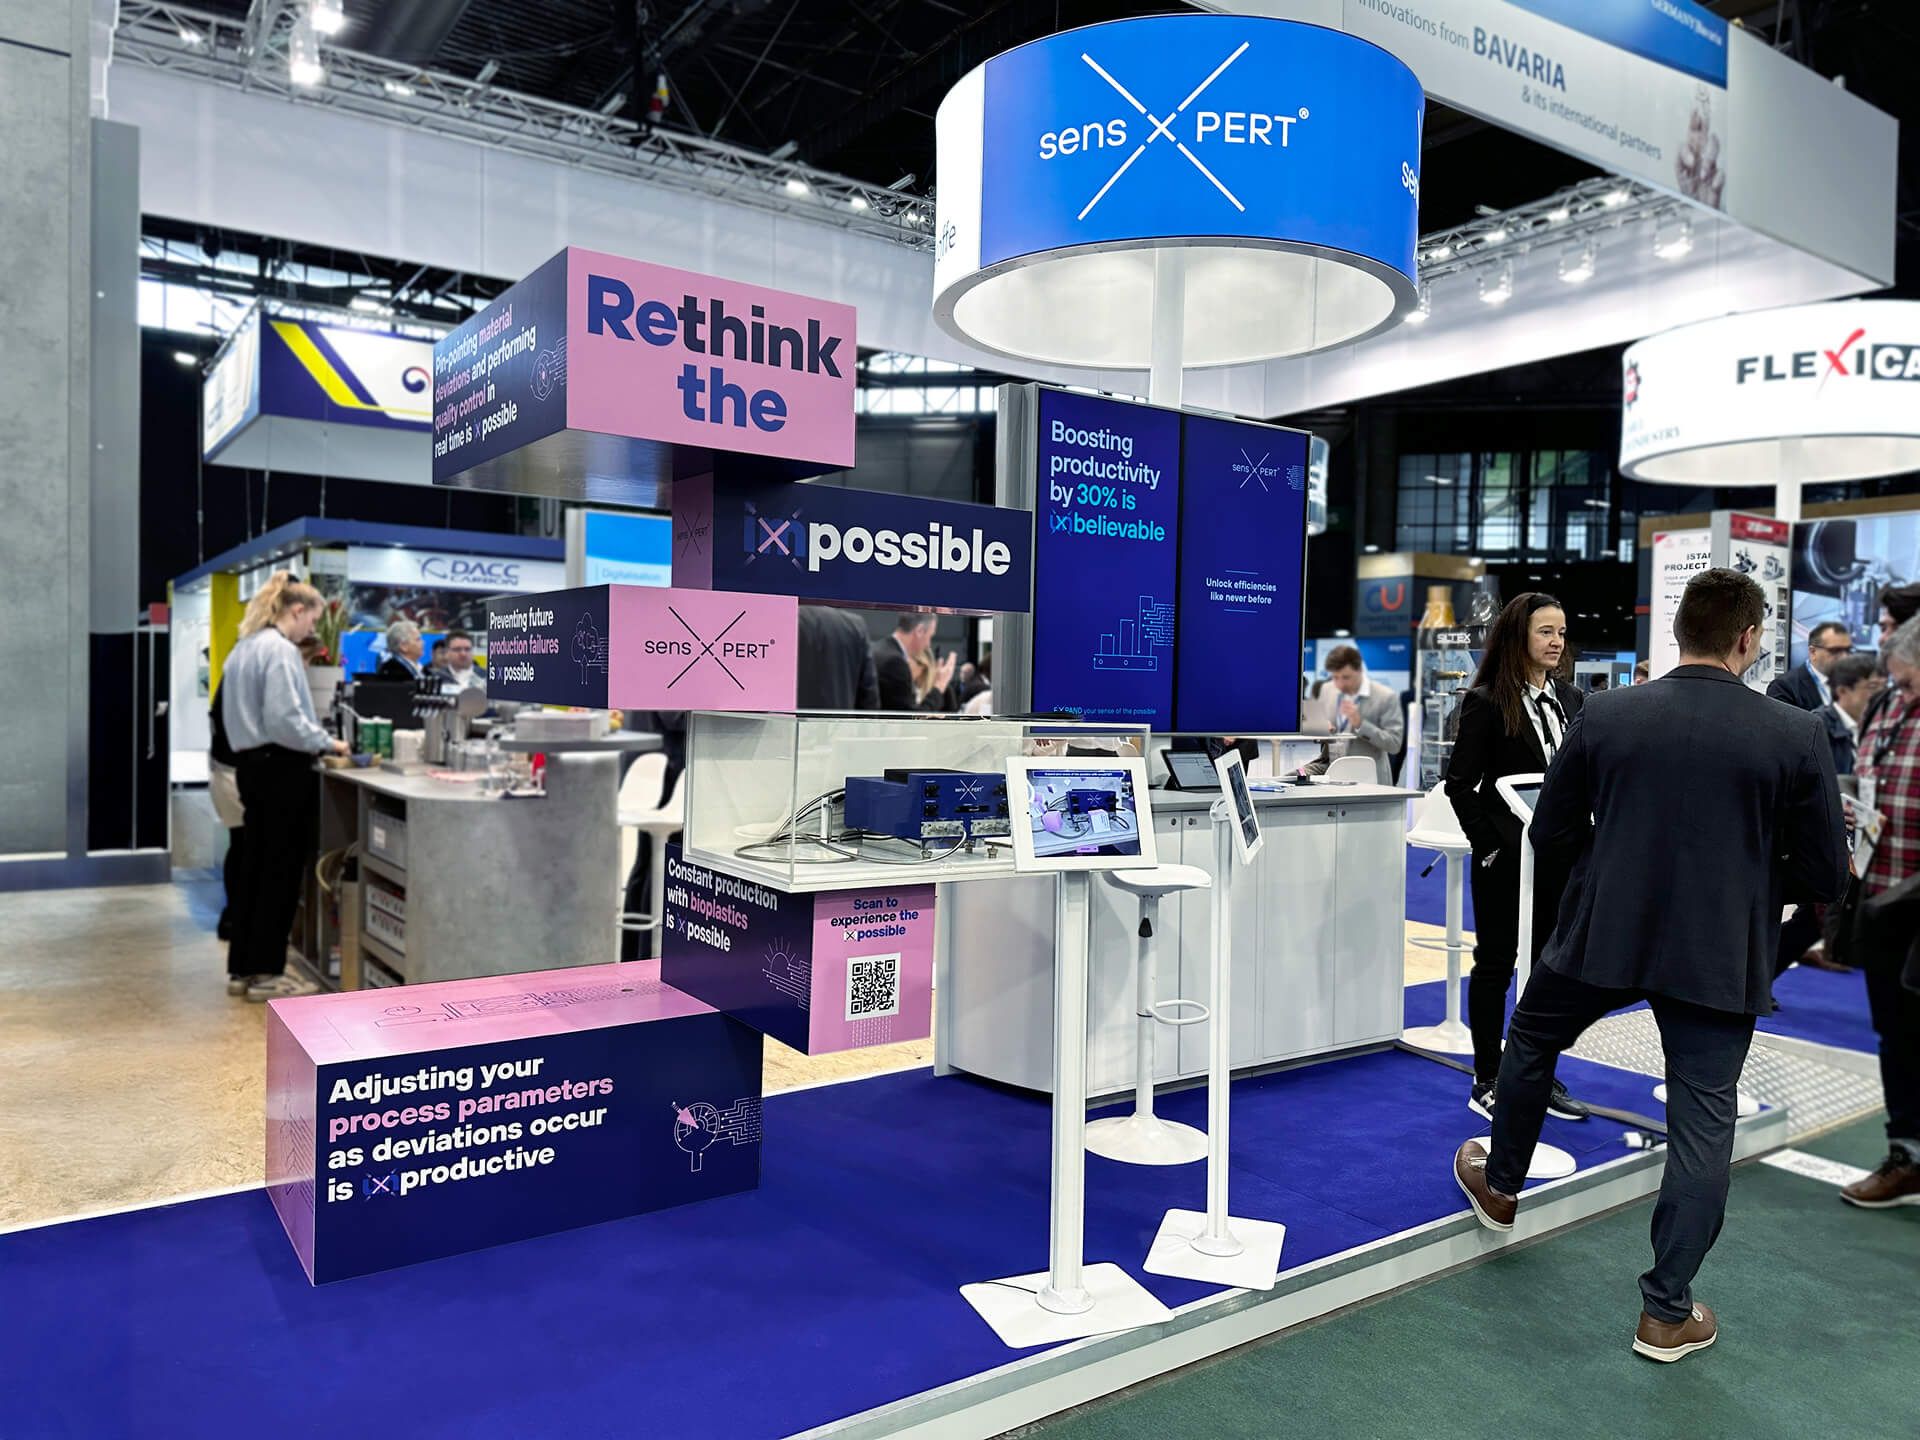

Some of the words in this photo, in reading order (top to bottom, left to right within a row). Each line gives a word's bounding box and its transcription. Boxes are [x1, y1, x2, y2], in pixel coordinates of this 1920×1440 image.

[1439, 21, 1468, 50] from
[1474, 27, 1565, 92] BAVARIA
[435, 332, 478, 376] Pin-pointing
[479, 303, 512, 347] material
[588, 274, 842, 379] Rethink
[435, 368, 471, 403] deviations
[472, 352, 488, 381] and
[488, 325, 536, 374] performing
[435, 403, 458, 434] quality
[459, 384, 486, 416] control
[487, 380, 495, 402] in
[677, 363, 787, 433] the
[435, 434, 448, 459] real
[449, 426, 465, 451] time
[465, 422, 473, 444] is
[1051, 420, 1133, 459] Boosting
[1050, 453, 1161, 490] productivity
[1050, 480, 1074, 508] by
[1077, 483, 1118, 509] 30%
[1122, 488, 1137, 511] is
[451, 559, 521, 578] DACC
[1206, 577, 1233, 589] Unlock
[1234, 579, 1277, 592] efficiencies
[1664, 562, 1708, 571] PROJECT
[1210, 591, 1225, 601] like
[1225, 593, 1246, 603] never
[1248, 594, 1272, 605] before
[490, 608, 528, 632] Preventing
[529, 606, 554, 627] future
[490, 636, 528, 660] production
[530, 634, 560, 654] failures
[489, 662, 496, 681] is
[668, 857, 713, 890] Constant
[716, 877, 778, 911] production
[667, 908, 675, 929] is
[668, 885, 696, 909] with
[691, 892, 749, 931] bioplastics
[831, 911, 896, 928] experience
[899, 909, 919, 921] the
[854, 898, 884, 911] Scan
[886, 897, 899, 908] to
[328, 1066, 473, 1105] Adjusting
[480, 1057, 544, 1094] your
[329, 1102, 450, 1142] process
[458, 1077, 614, 1122] parameters
[328, 1145, 364, 1170] as
[372, 1120, 523, 1162] deviations
[529, 1107, 607, 1137] occur
[328, 1178, 354, 1203] is
